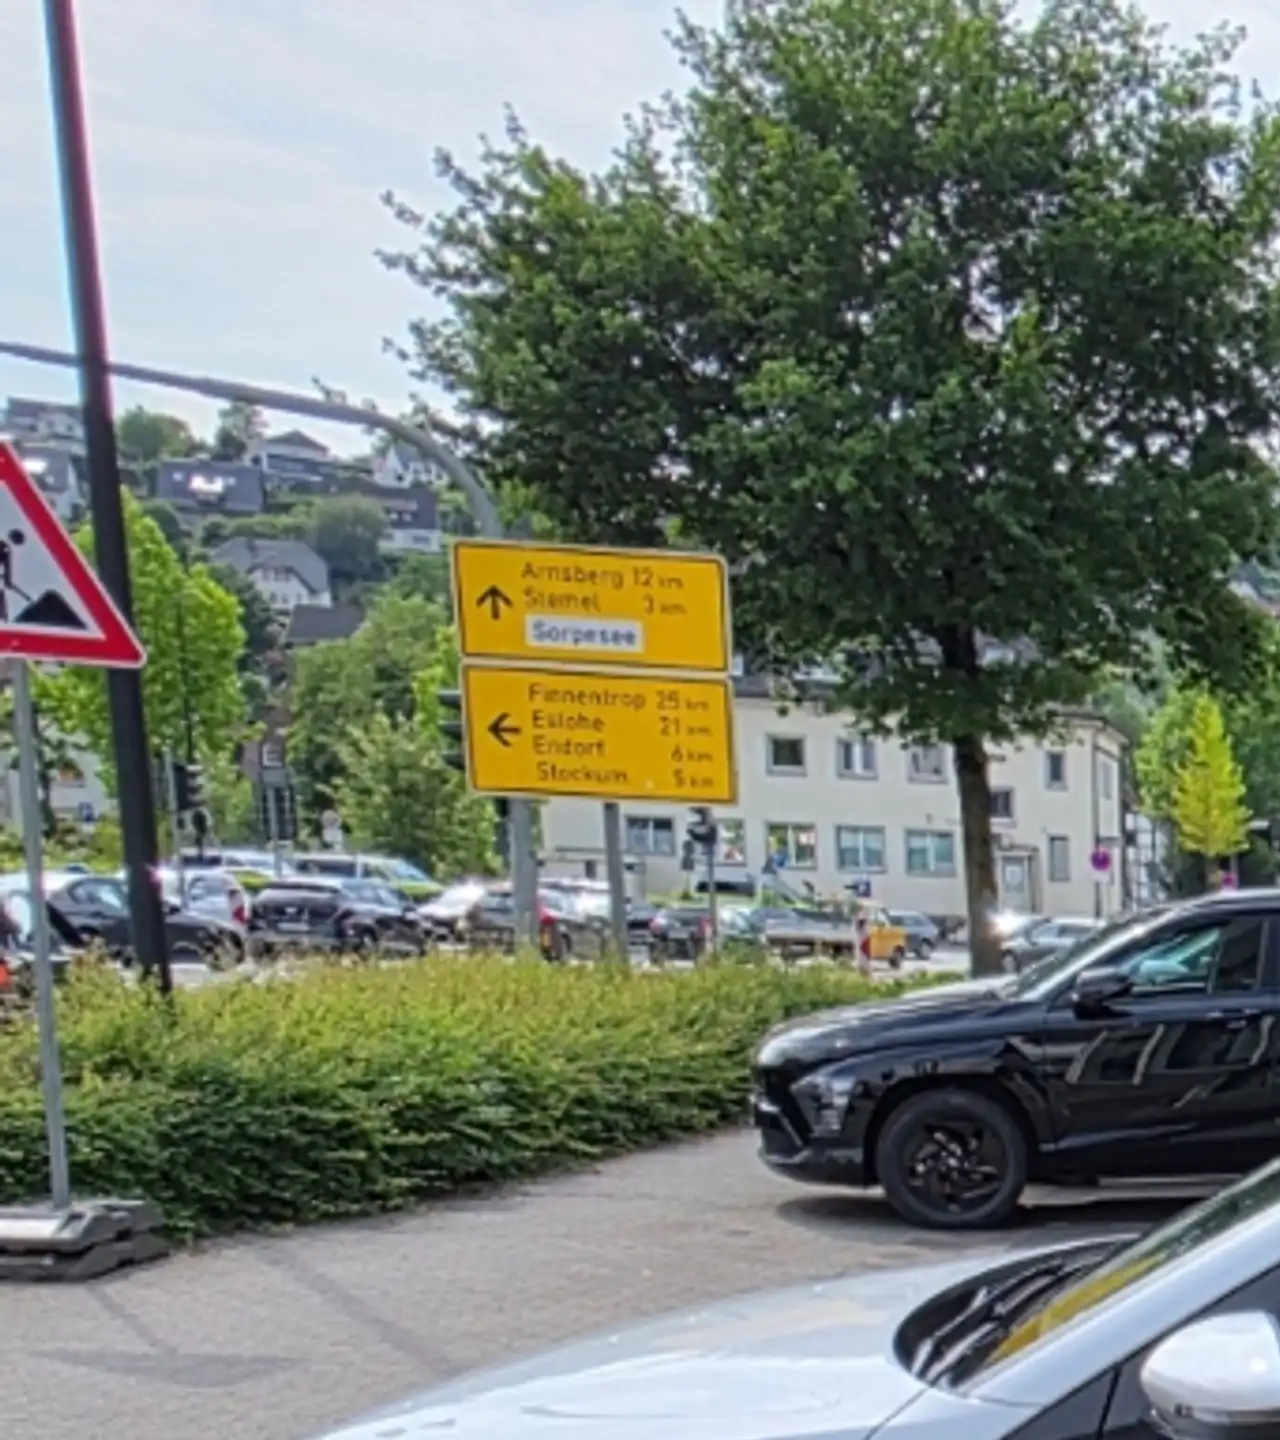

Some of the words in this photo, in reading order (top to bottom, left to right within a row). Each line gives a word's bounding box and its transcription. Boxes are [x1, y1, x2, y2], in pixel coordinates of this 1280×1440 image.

[521, 562, 625, 590] Arnsberg
[633, 566, 654, 587] 12
[532, 620, 637, 646] Sorpesee
[528, 682, 647, 711] Finnentrop
[659, 716, 680, 737] 21
[536, 761, 629, 784] Stockum
